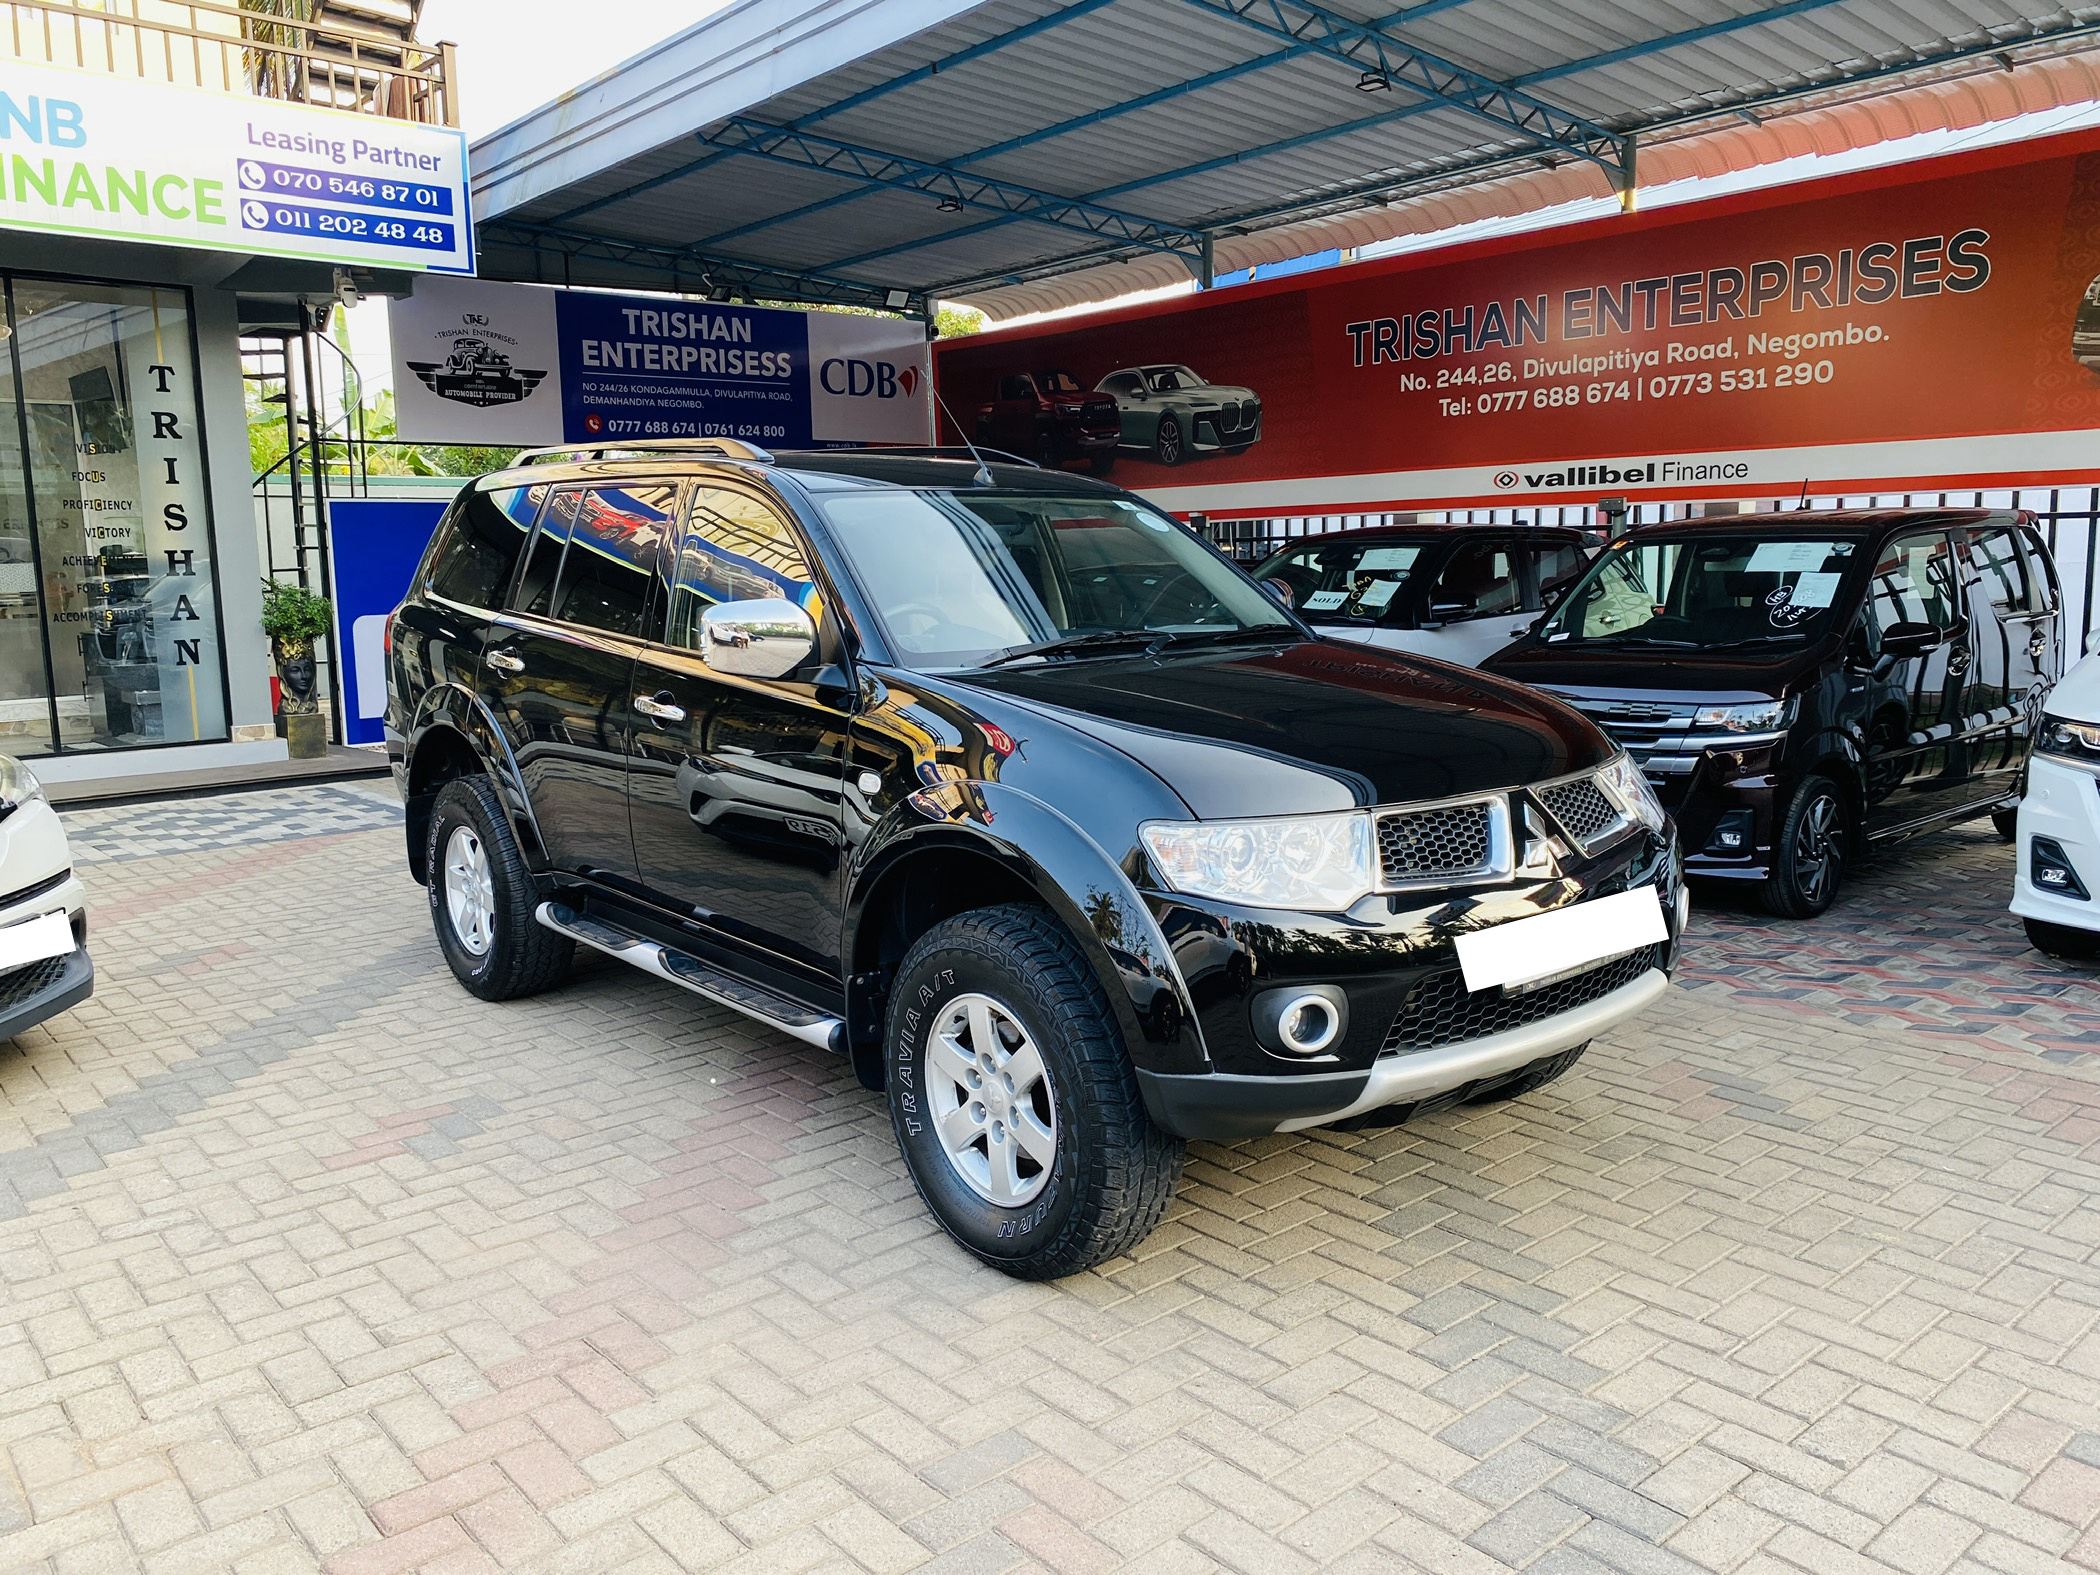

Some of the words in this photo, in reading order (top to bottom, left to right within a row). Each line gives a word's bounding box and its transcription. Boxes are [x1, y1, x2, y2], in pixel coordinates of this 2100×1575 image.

[247, 123, 346, 164] Leasing
[353, 140, 441, 171] Partner
[273, 170, 322, 191] 070
[329, 177, 375, 198] 546
[381, 185, 409, 202] 87
[416, 189, 438, 206] 01
[275, 209, 311, 228] 011
[319, 215, 367, 236] 202
[374, 222, 405, 239] 48
[413, 227, 443, 243] 48
[1346, 293, 1548, 367] TRISHAN
[1562, 227, 1992, 341] ENTERPRISES
[437, 329, 469, 338] TRISHAN
[472, 329, 516, 345] ENTERPRISES
[622, 308, 751, 342] TRISHAN
[582, 339, 792, 378] ENTERPRISESS
[1400, 373, 1431, 392] No.
[1436, 361, 1517, 388] 244,26,
[1523, 348, 1659, 377] Divulapitiya
[1667, 337, 1739, 363] Road,
[1748, 322, 1890, 359] Negombo.
[444, 389, 483, 398] AUTOMOBILE
[485, 392, 517, 400] PROVIDER
[582, 382, 597, 391] NO
[600, 383, 629, 393] 244/26
[631, 385, 712, 397] KONDAGAMMULLA,
[714, 389, 767, 400] DIVULAPITIYA
[768, 392, 793, 401] ROAD,
[819, 358, 898, 399] CDB
[1439, 397, 1472, 416] Tel:
[1477, 390, 1528, 413] 0777
[1533, 385, 1580, 408] 688
[1586, 381, 1630, 404] 674
[1650, 372, 1712, 398] 0773
[1720, 368, 1767, 391] 531
[1775, 360, 1834, 387] 290
[583, 396, 656, 407] DEMANHANDIYA
[657, 400, 705, 409] NEGOMBO.
[608, 420, 641, 433] 0777
[644, 421, 669, 434] 688
[672, 422, 696, 434] 674
[704, 423, 734, 436] 0761
[738, 425, 761, 437] 624
[763, 426, 785, 437] 800
[76, 443, 116, 454] VISION
[71, 471, 106, 483] FOCUS
[1524, 463, 1655, 488] vallibel
[1662, 461, 1748, 482] Finance
[63, 499, 133, 511] PROFICIENCY
[148, 365, 200, 666] TRISHAN
[84, 526, 131, 539] VICTORY
[53, 609, 147, 622] ACCOMPLISHMENT
[429, 815, 446, 874] RADIAL
[899, 1006, 922, 1136] TRAVIA
[918, 969, 955, 1007] A/T
